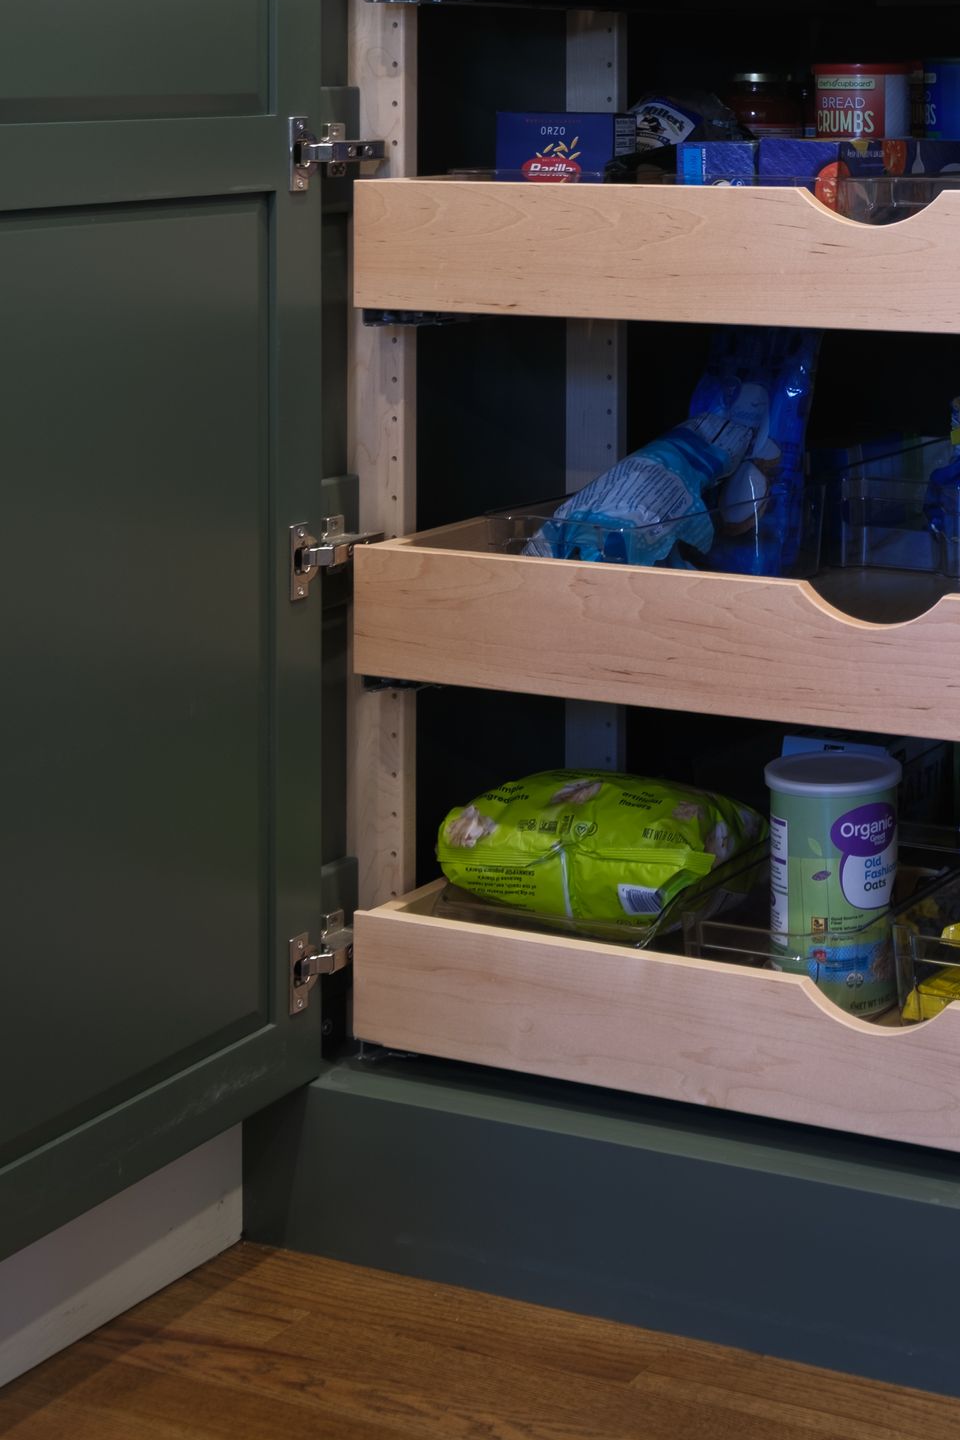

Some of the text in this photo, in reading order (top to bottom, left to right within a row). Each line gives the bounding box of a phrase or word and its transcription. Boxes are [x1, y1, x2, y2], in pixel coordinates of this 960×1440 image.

[822, 96, 866, 109] BREAD
[817, 110, 875, 134] CRUMBS
[540, 126, 566, 136] ORZO
[840, 815, 894, 841] Organic
[865, 856, 882, 869] Old
[863, 879, 887, 892] Oats
